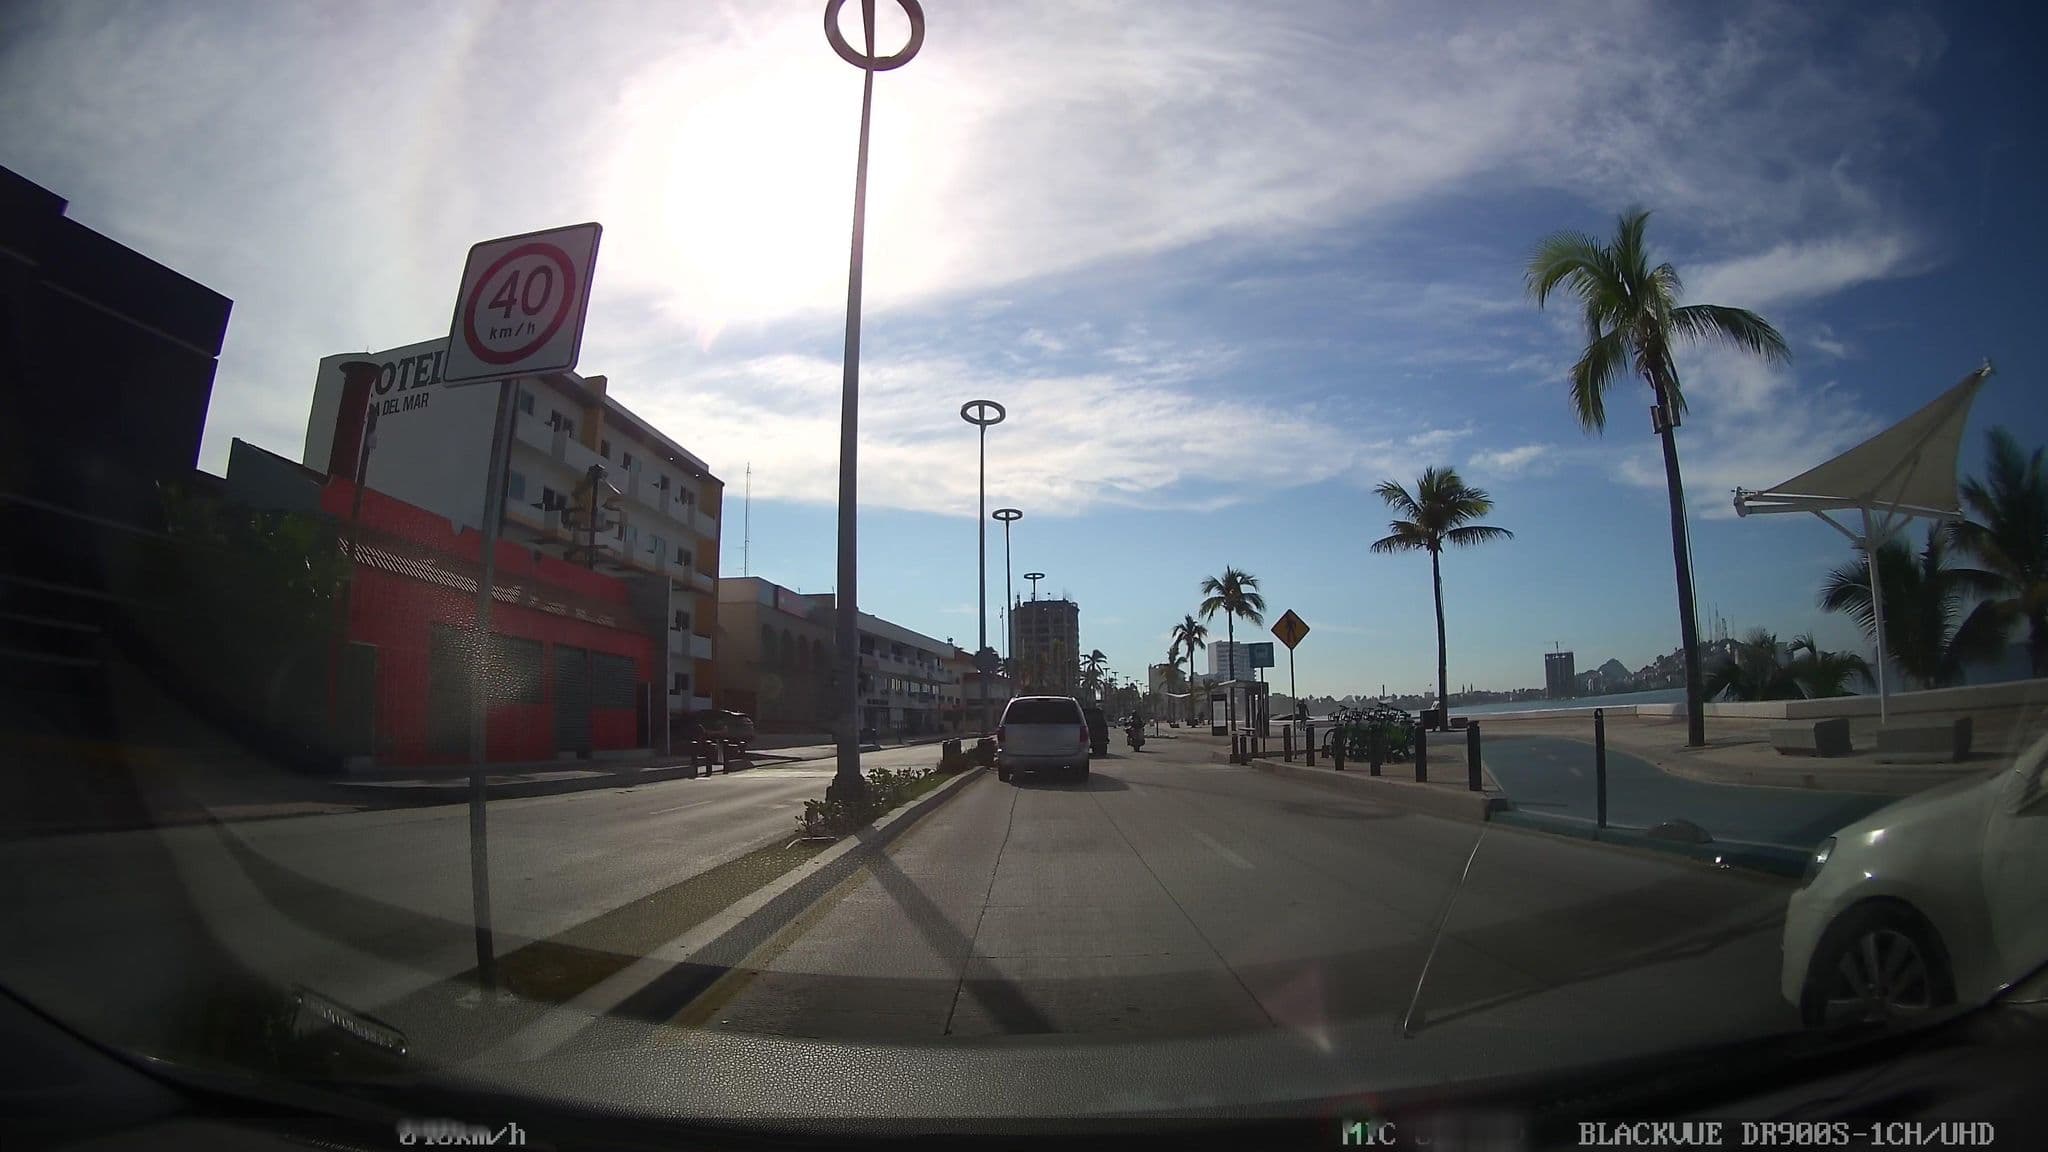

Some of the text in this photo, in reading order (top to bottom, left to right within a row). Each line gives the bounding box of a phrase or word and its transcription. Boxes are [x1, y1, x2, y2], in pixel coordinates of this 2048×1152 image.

[488, 265, 553, 319] 40
[489, 322, 535, 339] km/h
[373, 350, 445, 396] OTEL
[382, 398, 400, 417] DEL
[402, 392, 429, 412] MAR
